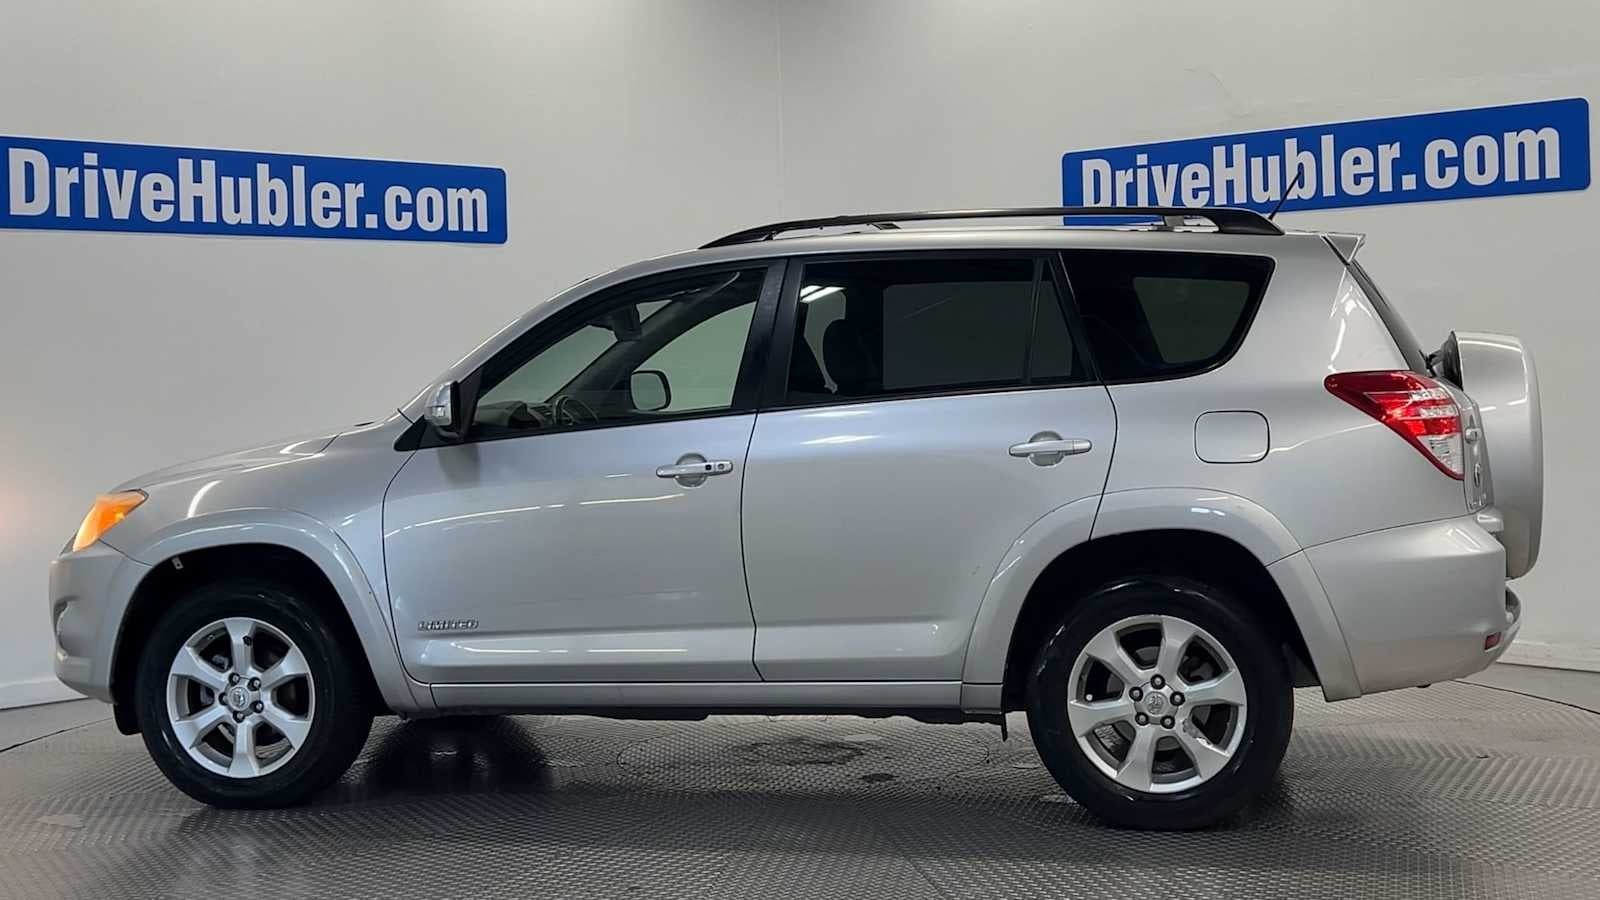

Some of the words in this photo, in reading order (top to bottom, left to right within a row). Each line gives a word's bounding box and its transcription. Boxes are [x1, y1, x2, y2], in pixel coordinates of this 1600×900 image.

[8, 147, 488, 232] DriveHubler.com
[1081, 126, 1561, 208] DriveHubler.com
[418, 619, 479, 631] LIMITED
